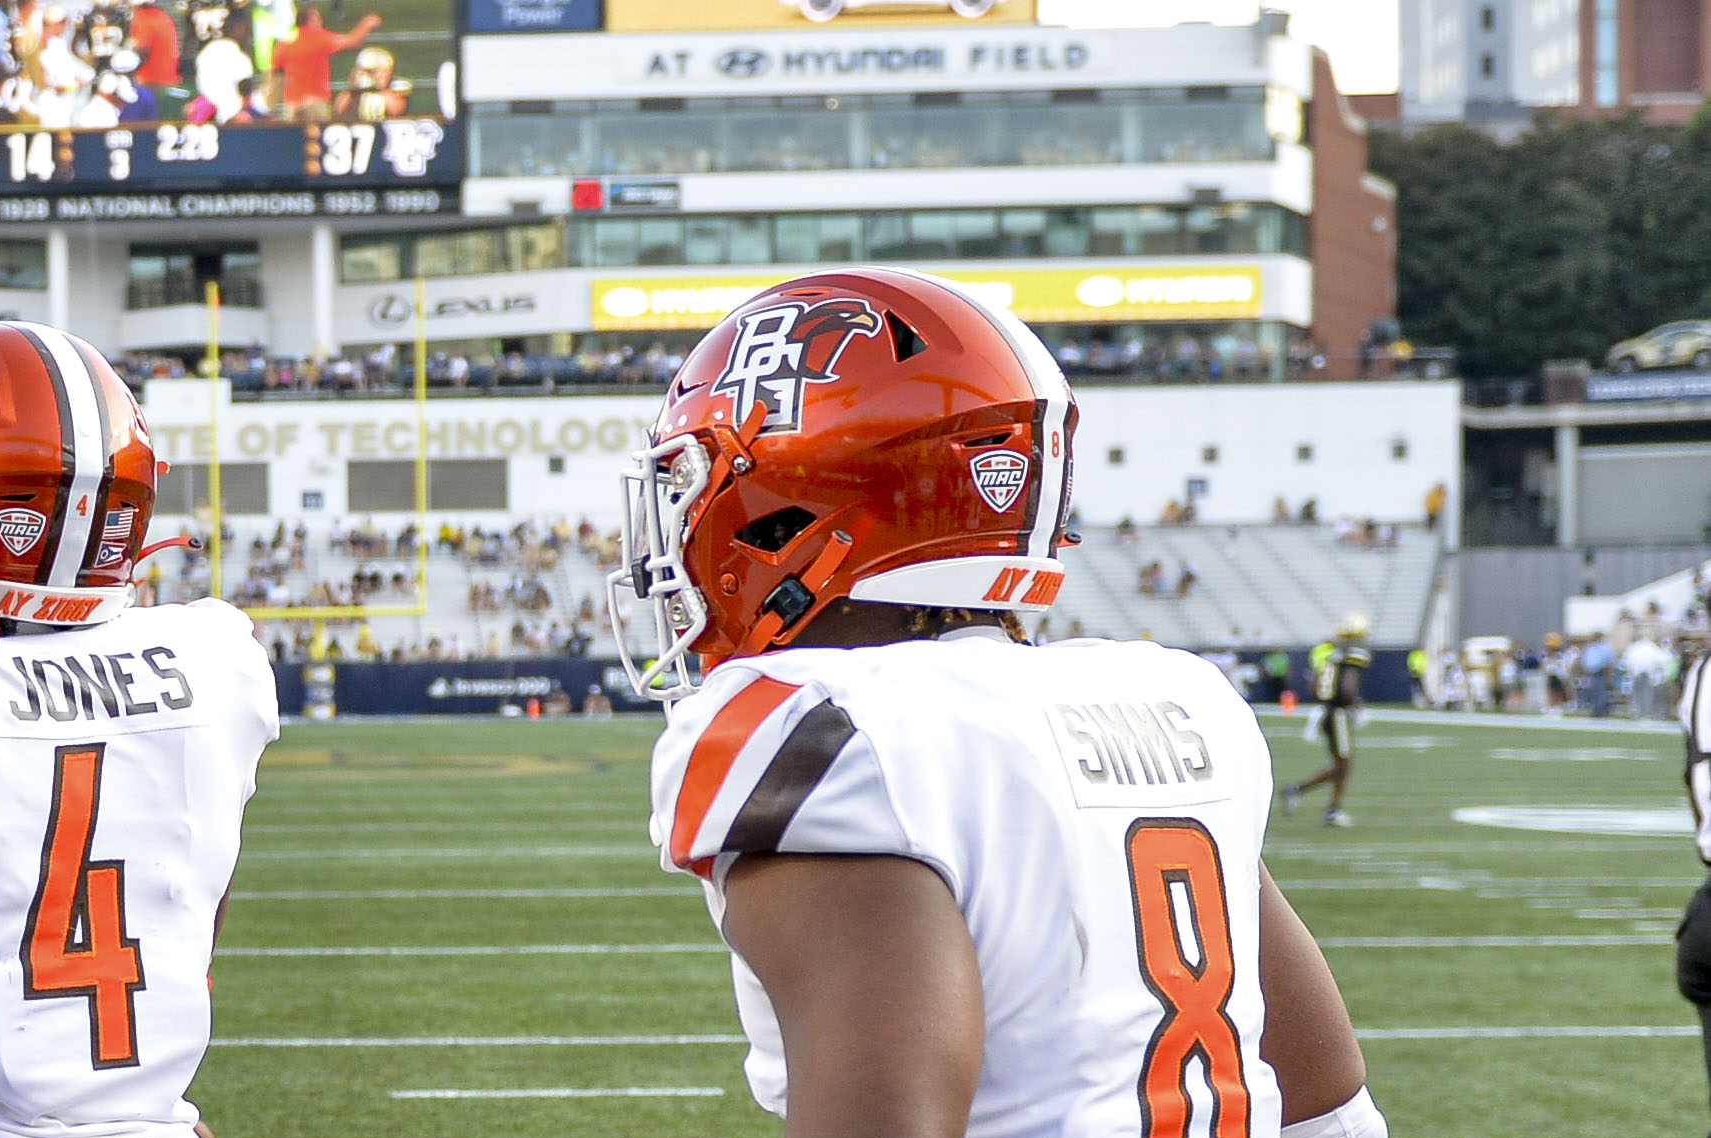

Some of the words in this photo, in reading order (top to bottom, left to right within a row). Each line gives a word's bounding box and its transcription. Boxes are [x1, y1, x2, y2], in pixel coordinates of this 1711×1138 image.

[647, 52, 691, 77] AT
[784, 47, 943, 74] HYUNDAI
[971, 43, 1089, 70] FIELD
[7, 133, 55, 182] 14
[322, 124, 375, 175] 37
[57, 197, 174, 219] NATIONAL
[180, 192, 315, 216] CHAMPIONS
[238, 422, 300, 457] OF
[1051, 431, 1060, 458] 8
[978, 470, 1023, 486] MAC
[75, 494, 89, 517] 4
[0, 522, 40, 537] MAC
[8, 646, 194, 722] JONES
[1055, 700, 1214, 785] SIMMS
[18, 742, 147, 1071] 4
